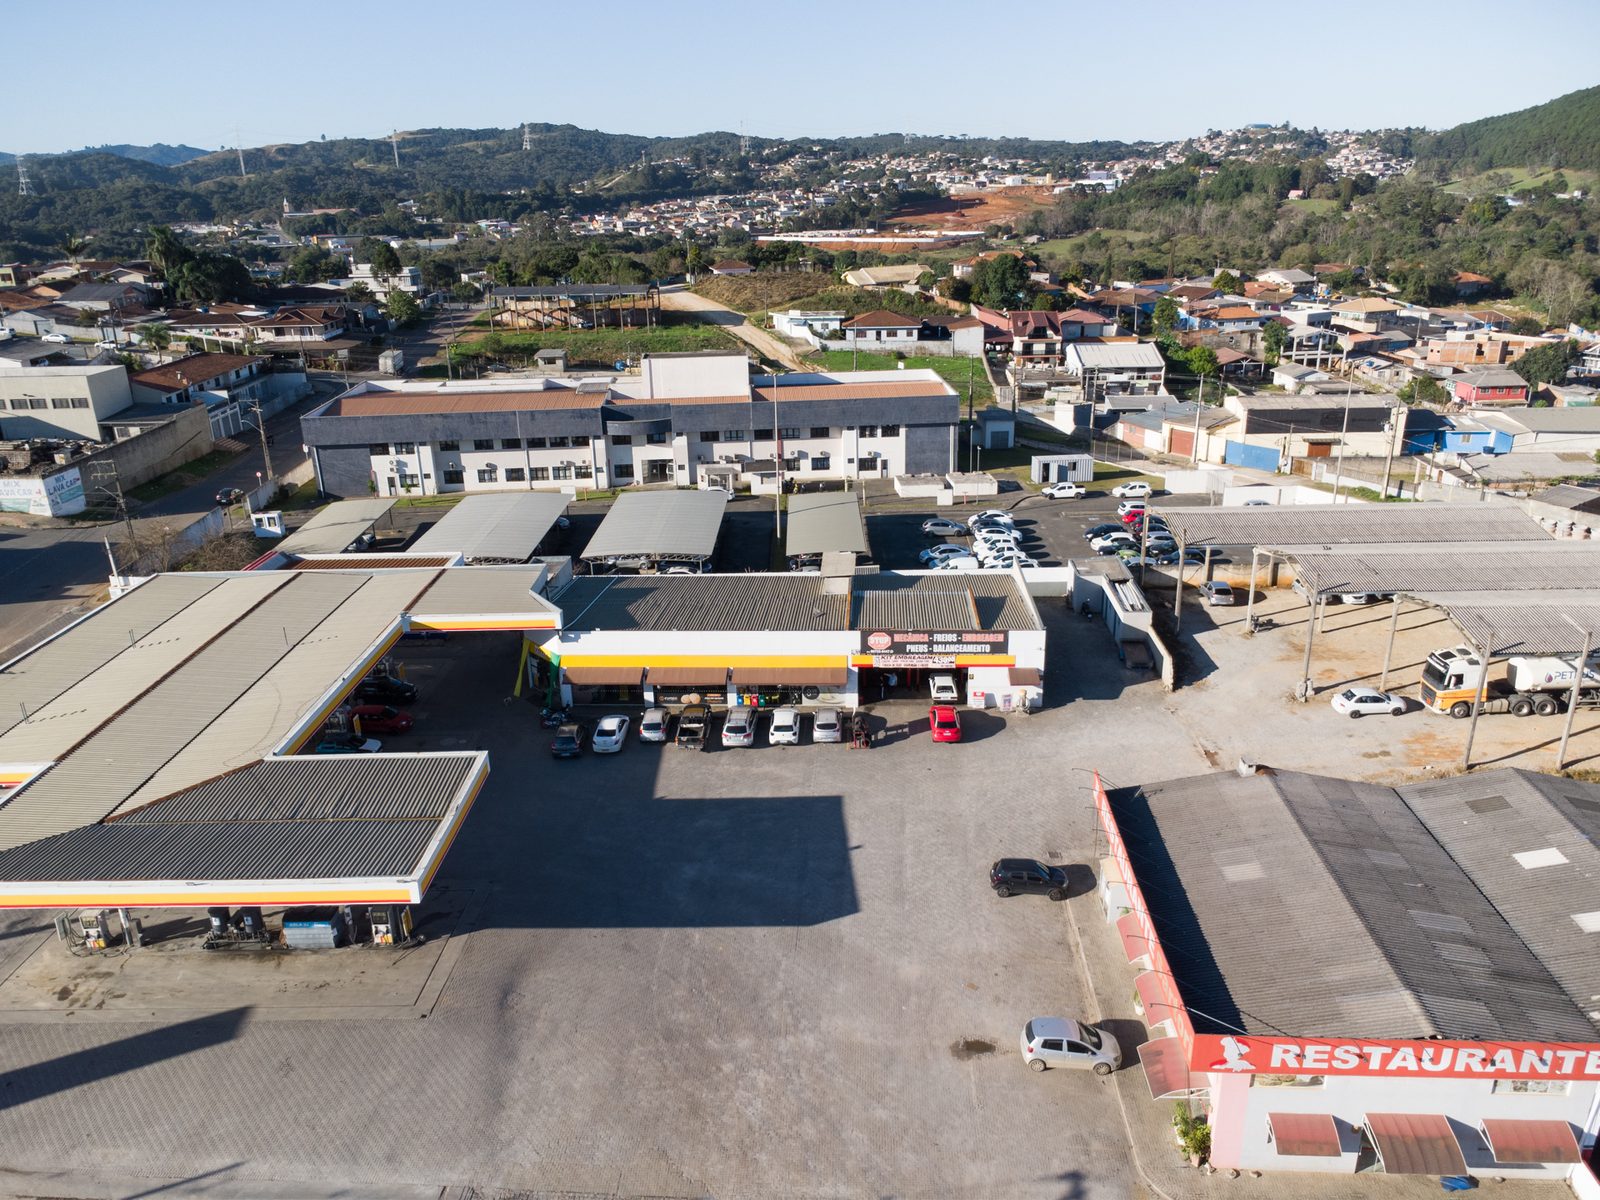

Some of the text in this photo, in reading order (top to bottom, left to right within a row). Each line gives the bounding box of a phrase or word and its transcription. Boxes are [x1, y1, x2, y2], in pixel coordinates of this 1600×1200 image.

[0, 488, 16, 496] AVA
[48, 484, 65, 495] LAVA
[868, 636, 889, 644] STOP
[933, 633, 957, 642] FREIOS
[906, 644, 928, 653] PNEUS
[933, 644, 991, 653] BALANCEAMENTO
[1270, 1044, 1600, 1074] RESTAURANTE
